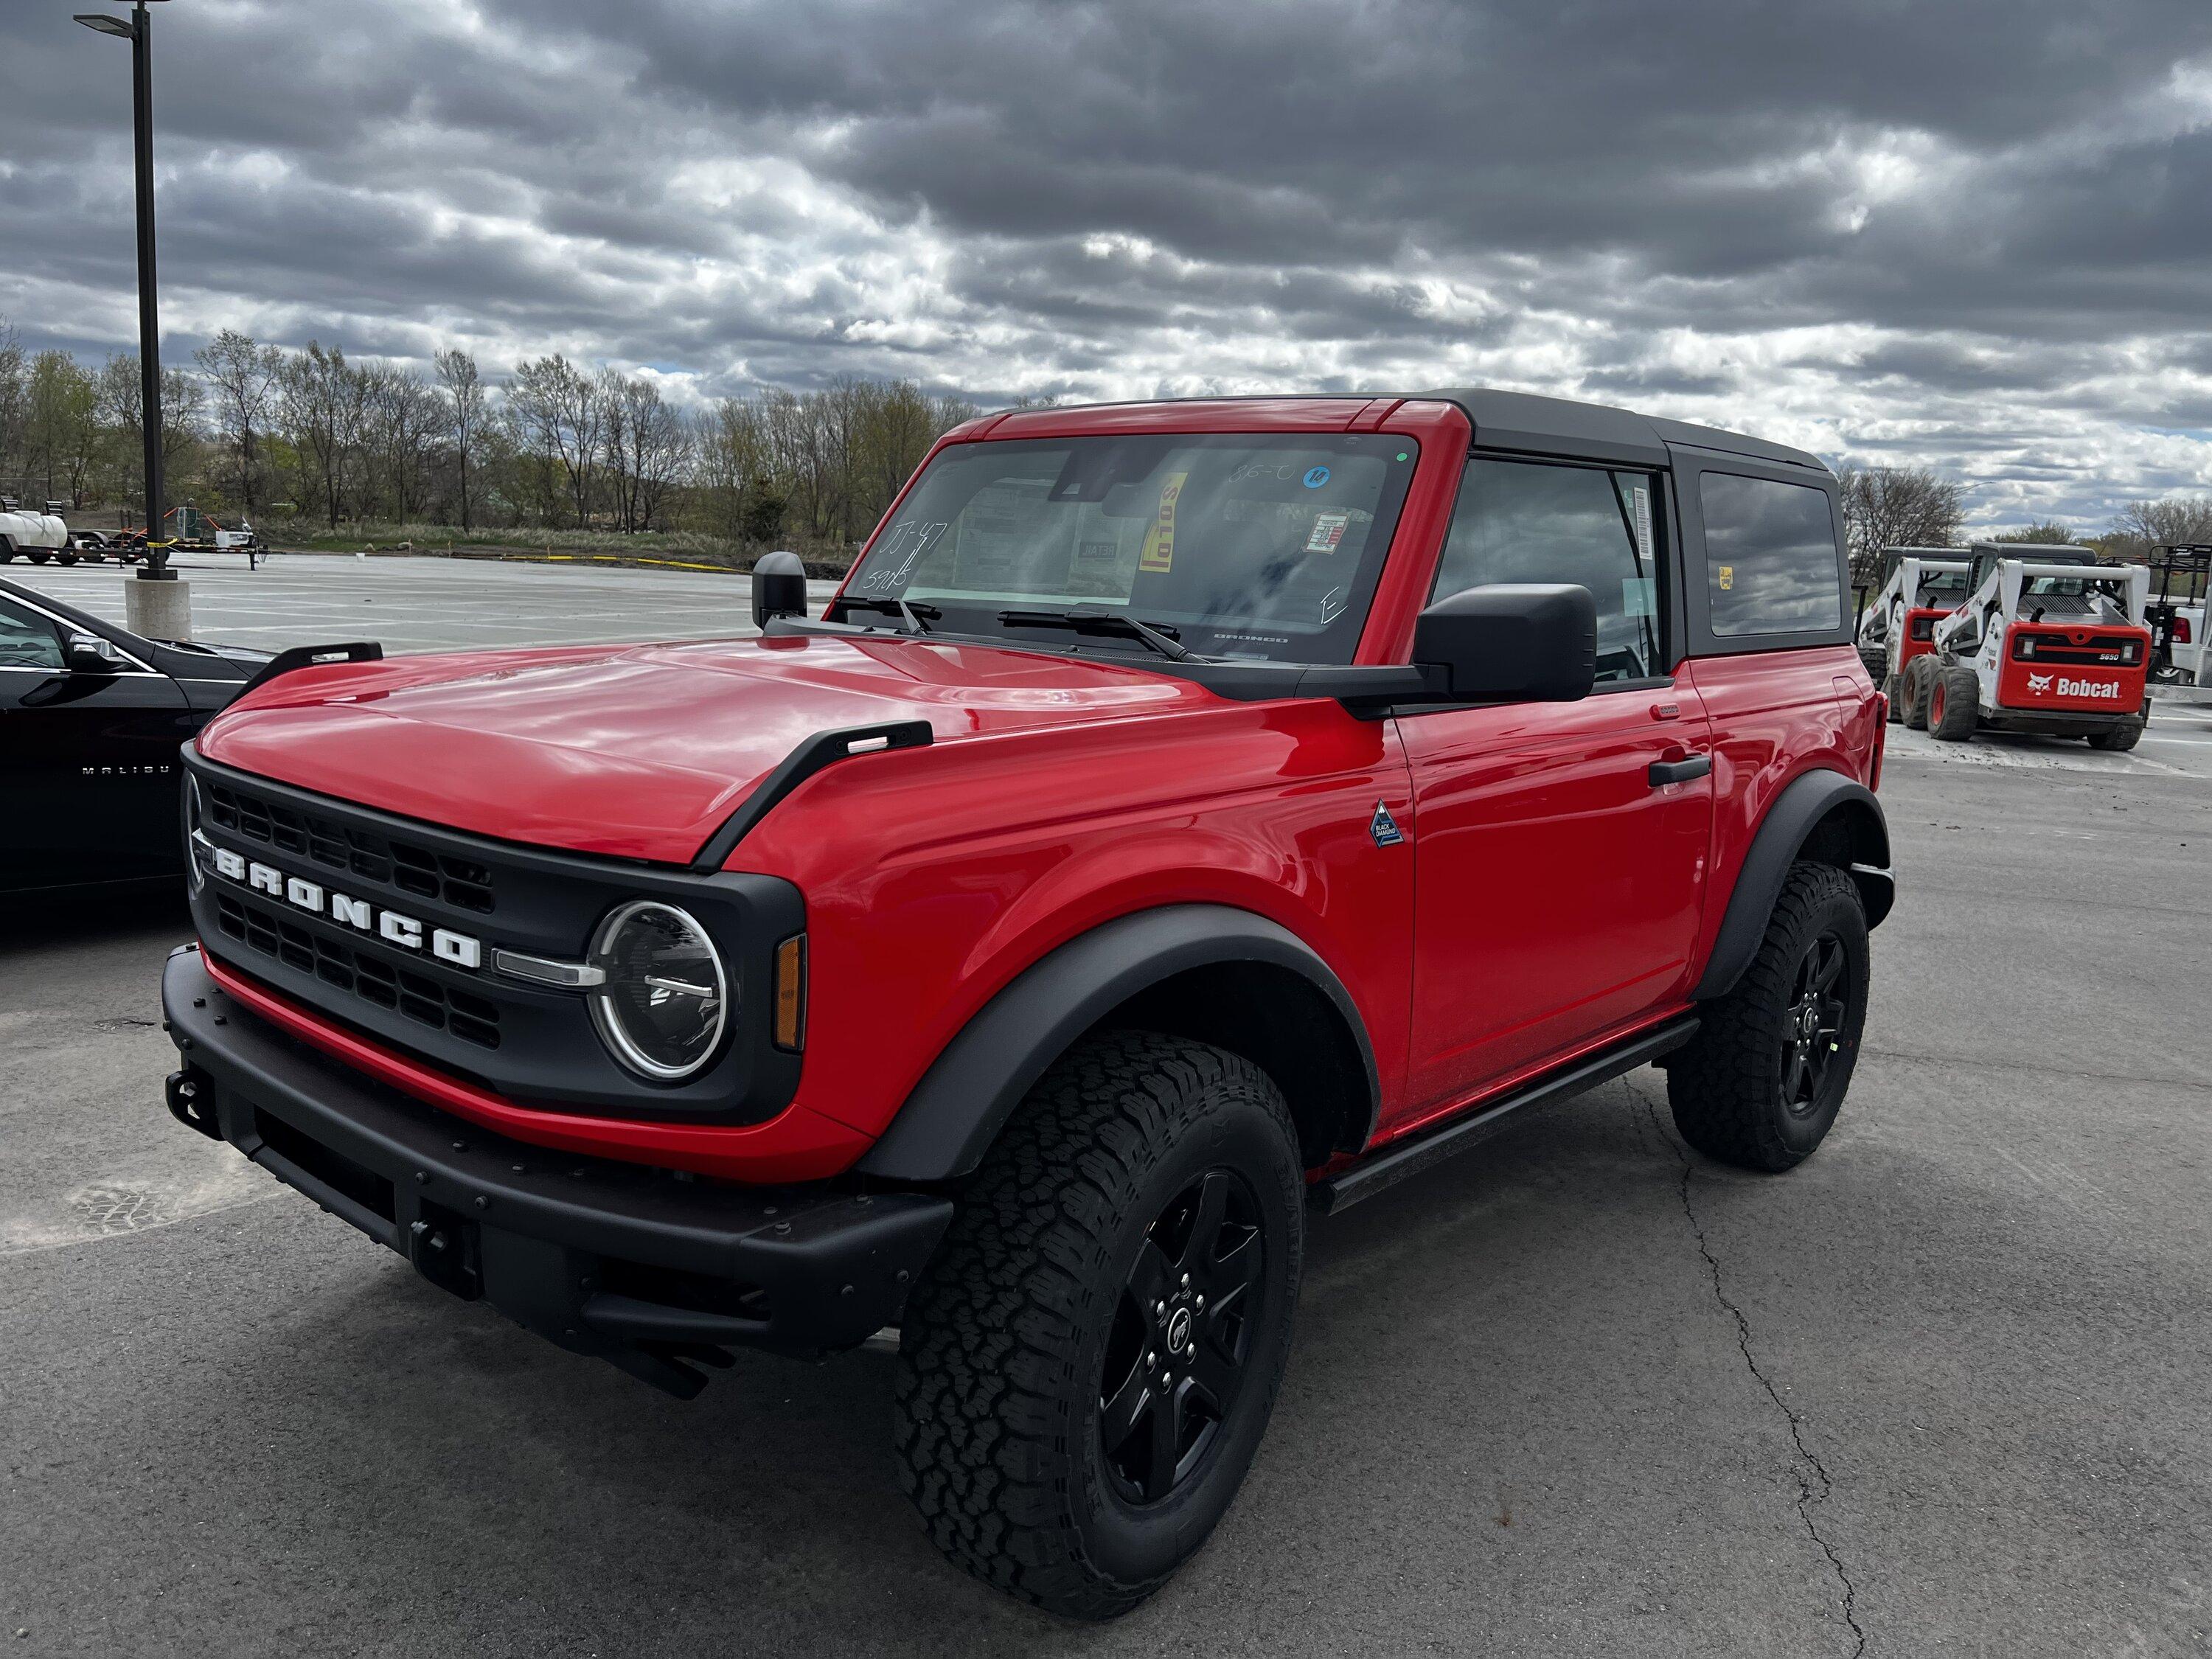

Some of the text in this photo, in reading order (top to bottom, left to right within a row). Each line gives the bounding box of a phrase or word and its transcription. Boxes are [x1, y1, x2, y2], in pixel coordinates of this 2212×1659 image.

[1158, 487, 1178, 558] SOLD
[1214, 633, 1288, 644] BRONCO
[2056, 678, 2120, 698] Bobcat
[83, 765, 169, 774] MALIBU
[1376, 828, 1395, 836] DIAMOND
[217, 848, 481, 968] BRONCO
